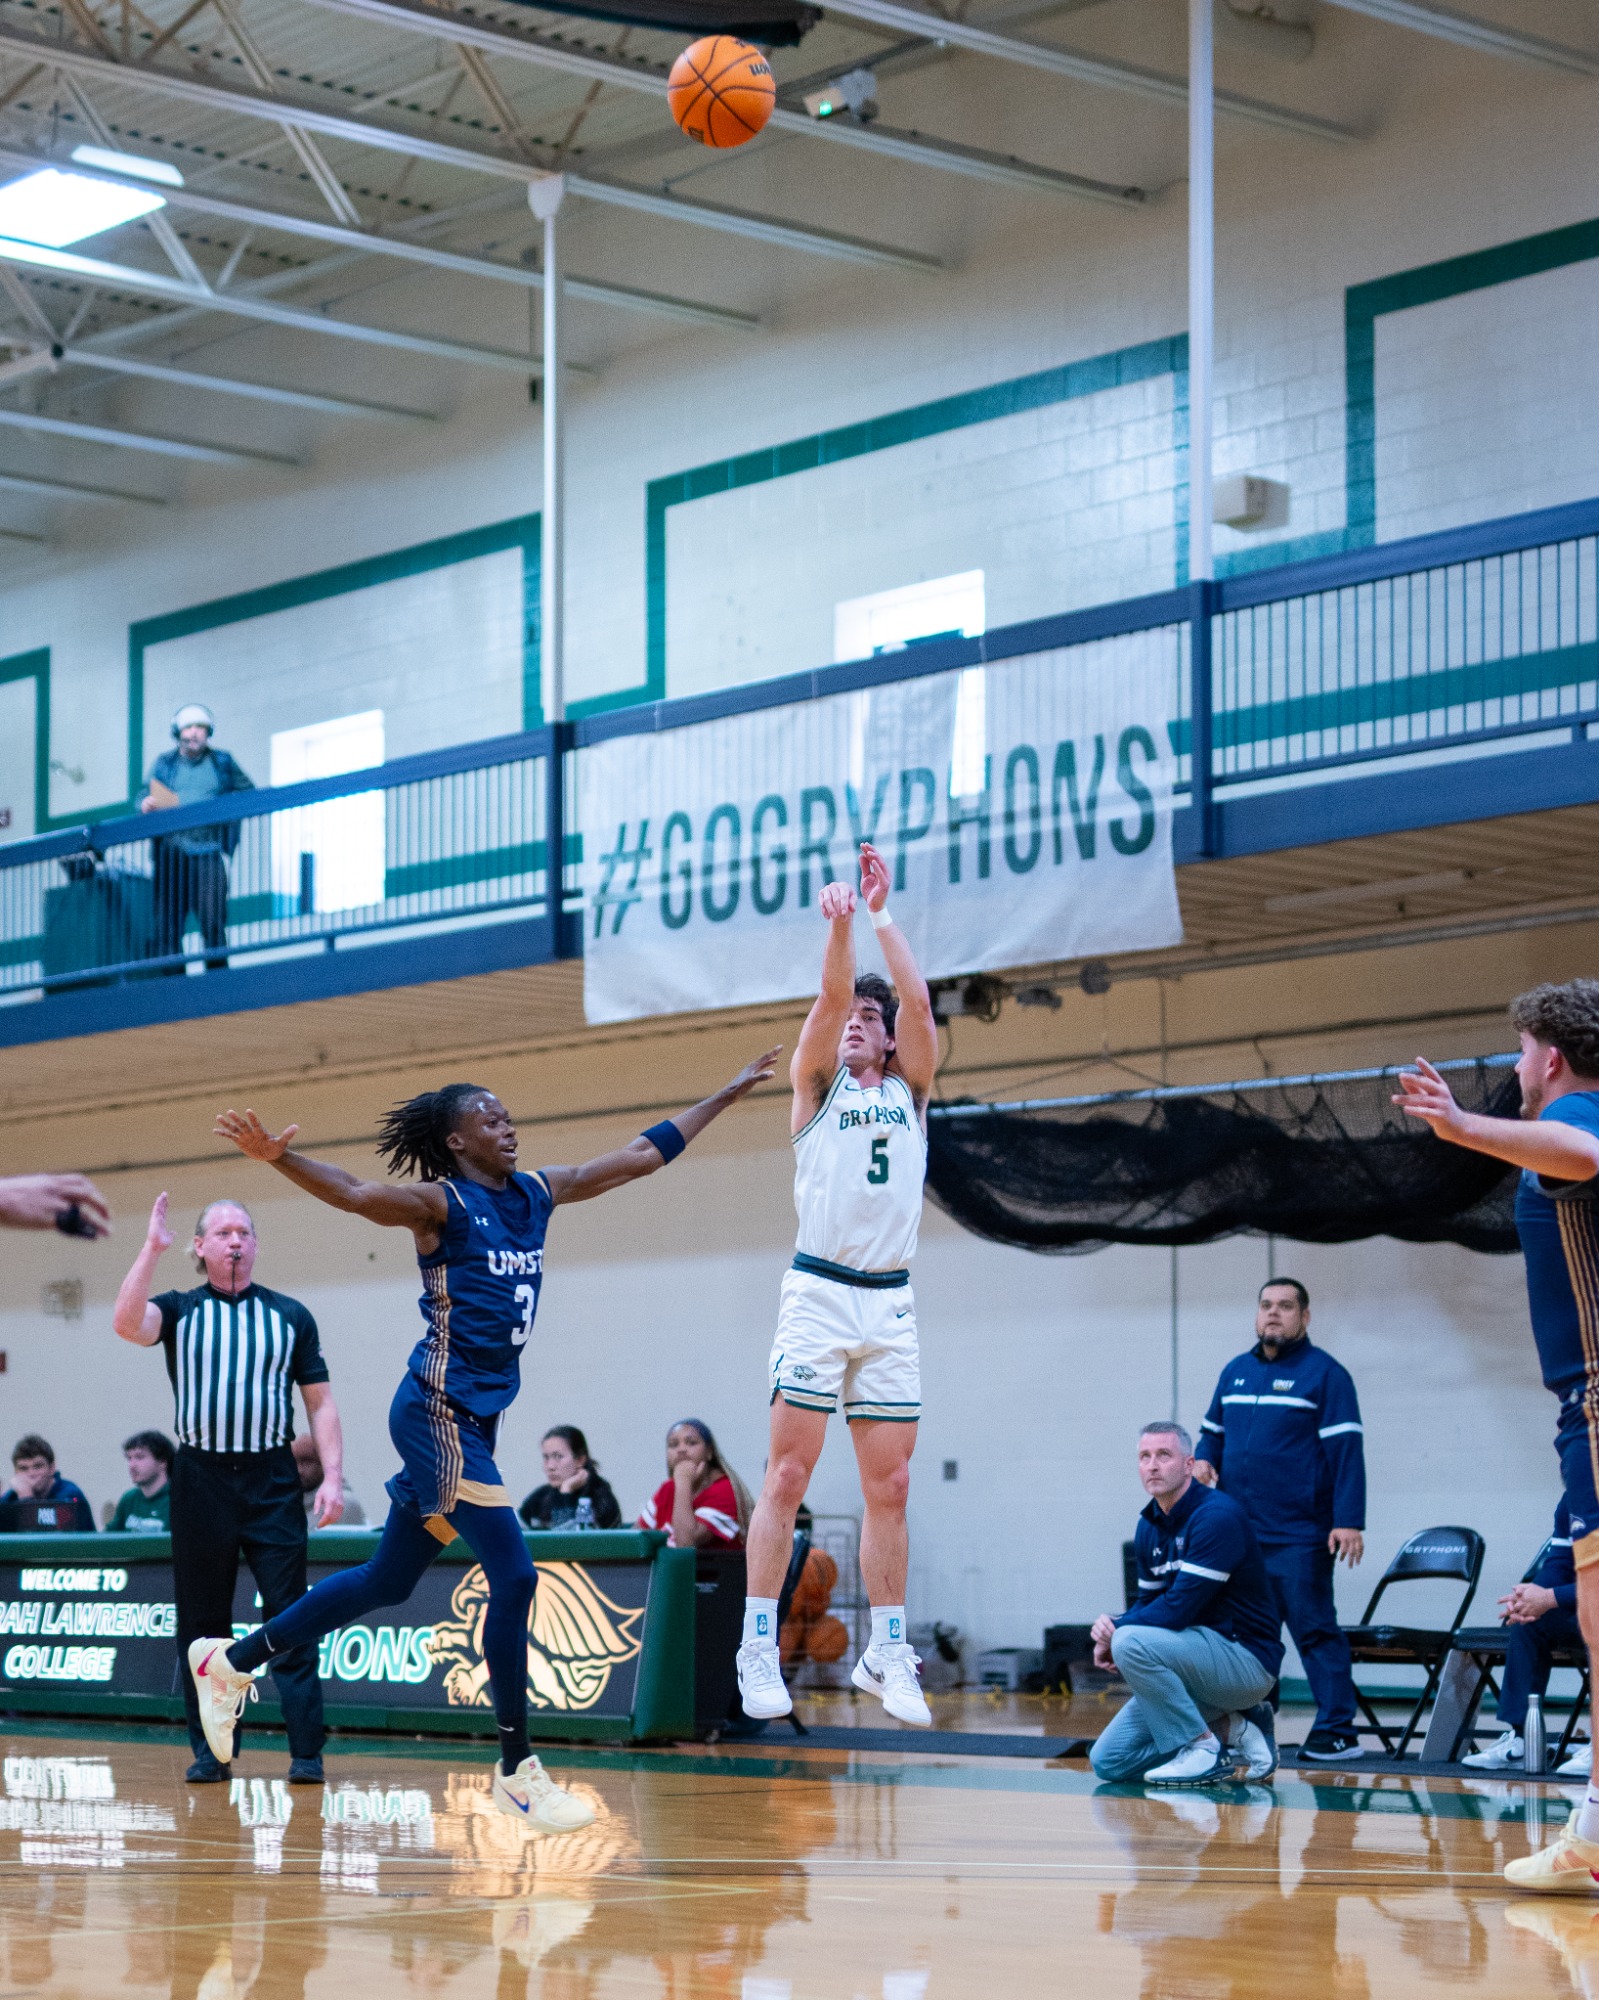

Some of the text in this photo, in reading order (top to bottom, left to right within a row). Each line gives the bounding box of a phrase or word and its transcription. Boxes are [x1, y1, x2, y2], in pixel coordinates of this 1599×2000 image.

[593, 724, 1158, 938] #GOGRYPHONS
[867, 1138, 889, 1185] 5
[511, 1284, 535, 1346] 3
[20, 1568, 129, 1592] WELCOME TO
[40, 1602, 178, 1637] LAWRENCE
[5, 1644, 118, 1681] COLLEGE
